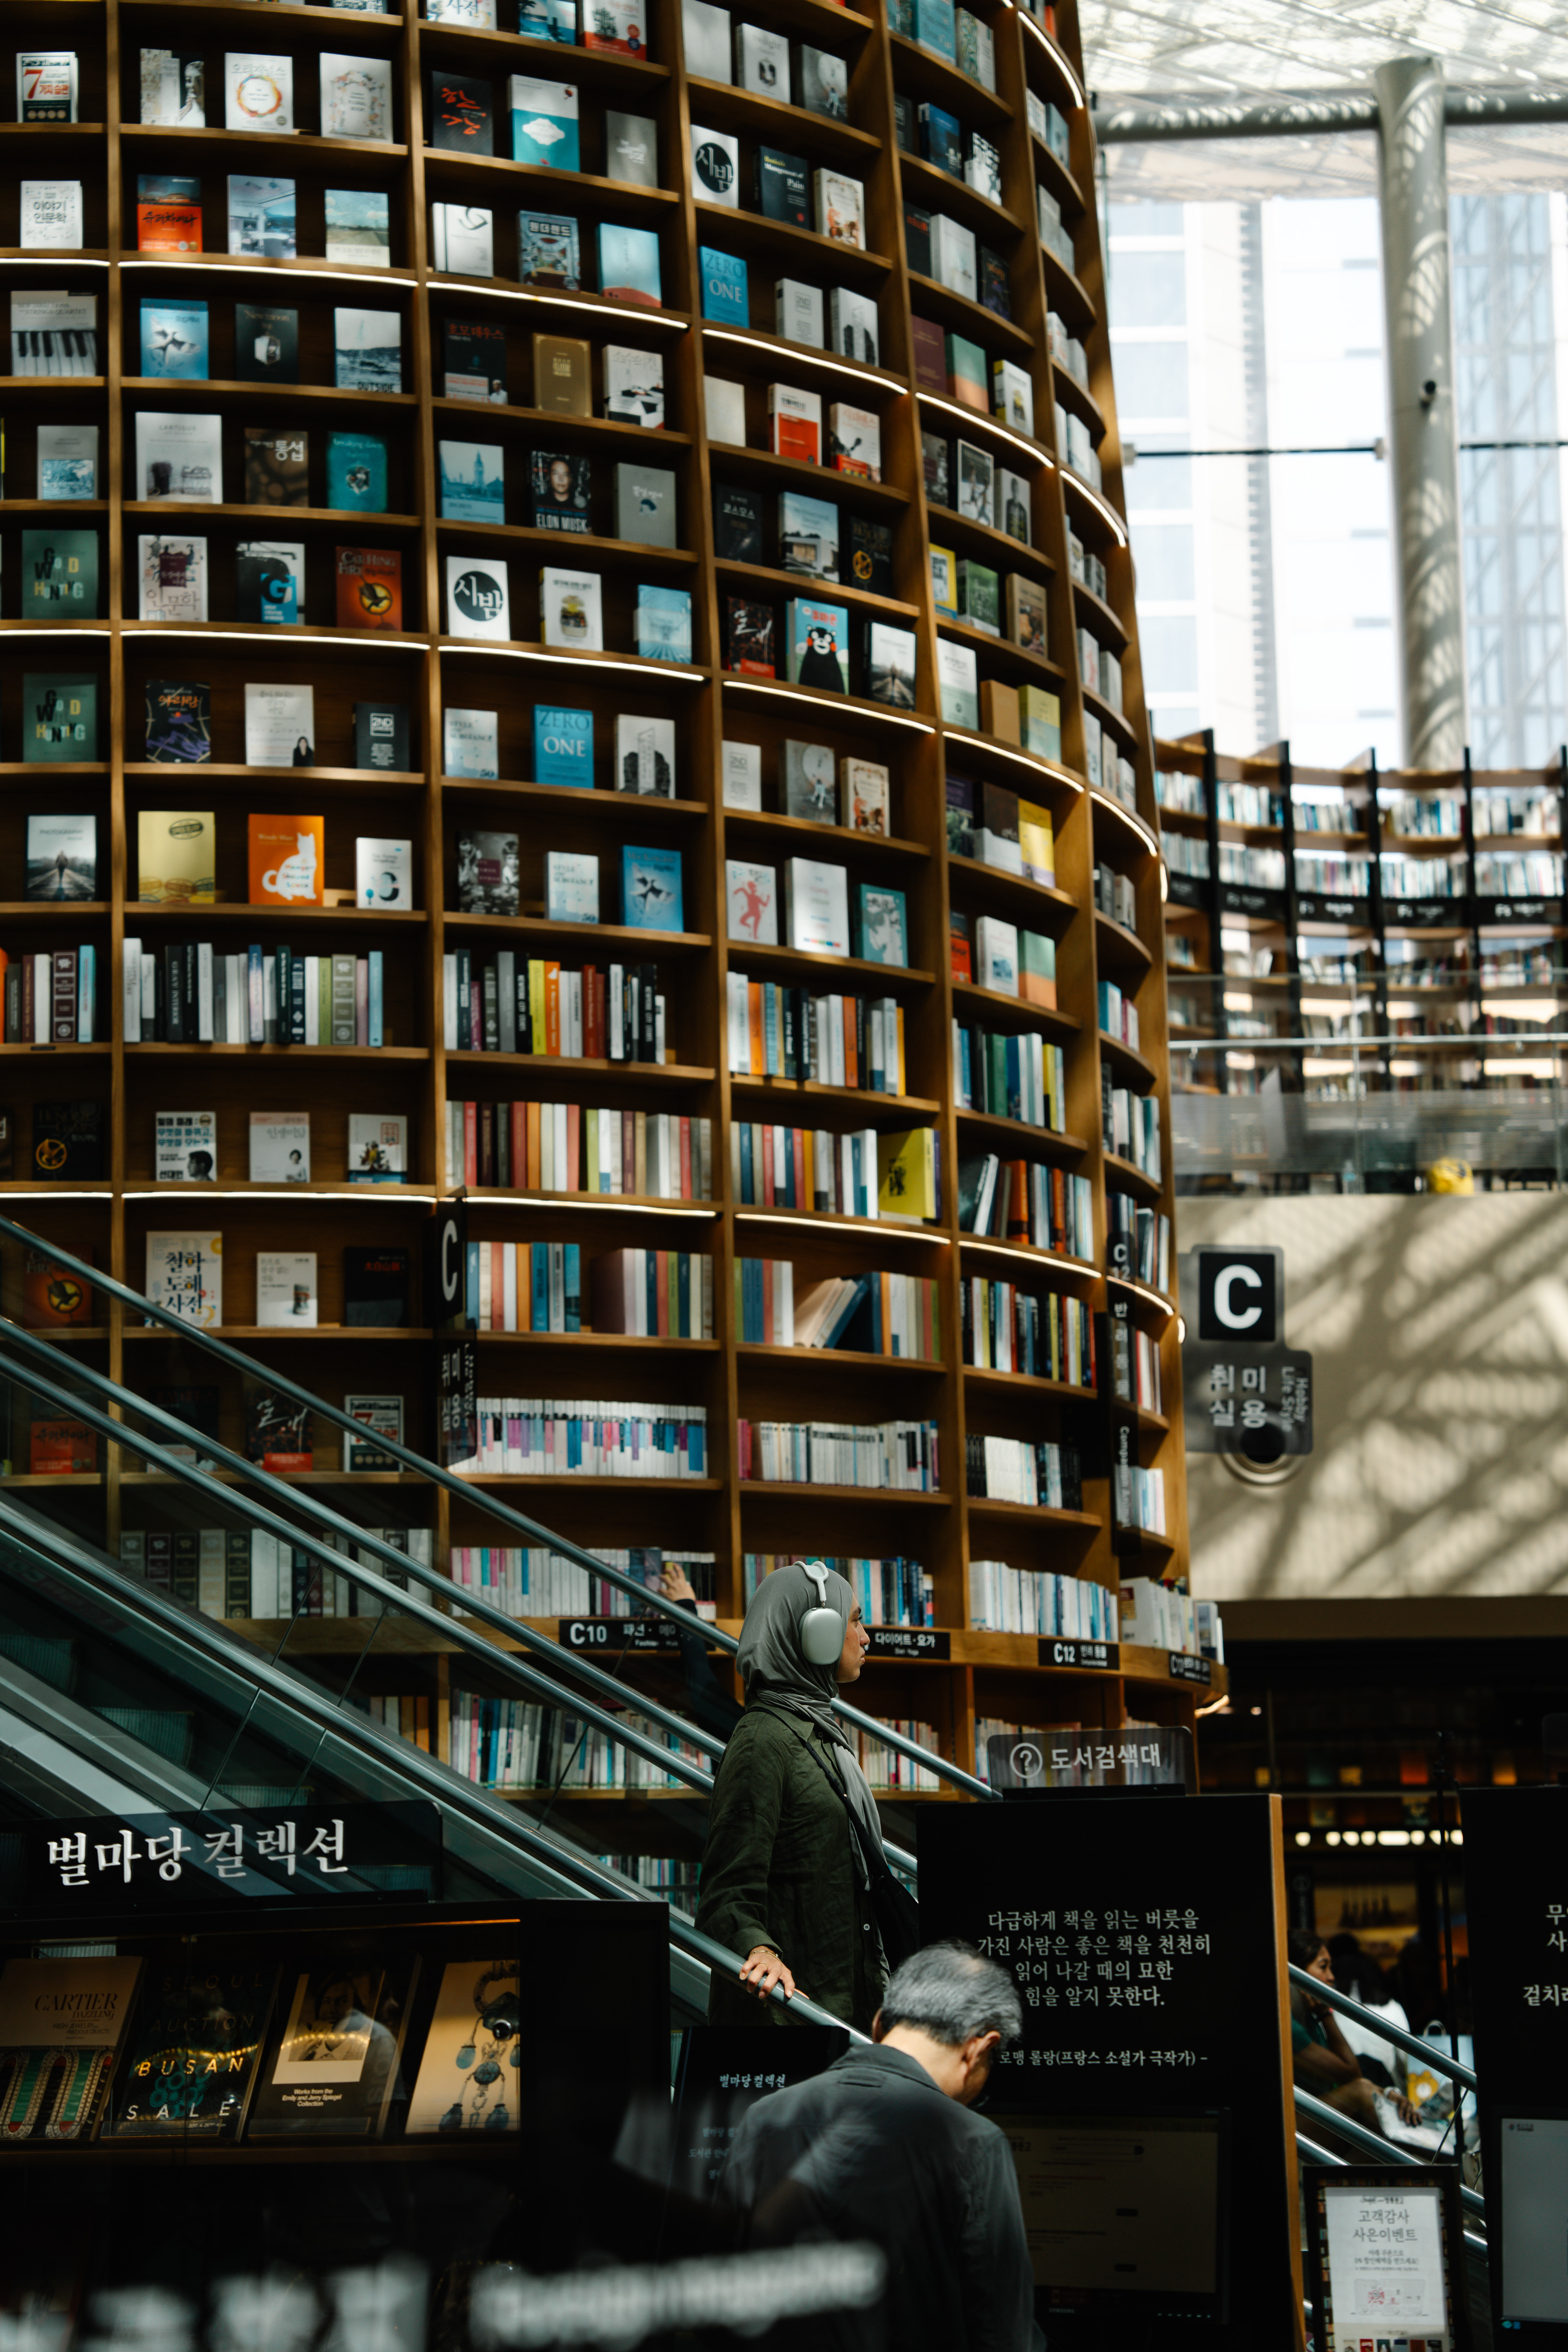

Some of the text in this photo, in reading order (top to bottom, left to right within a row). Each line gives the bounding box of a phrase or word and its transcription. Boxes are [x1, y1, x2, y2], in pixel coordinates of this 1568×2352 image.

[23, 69, 44, 99] 7
[34, 200, 67, 212] 이야기
[34, 212, 67, 224] 인문학
[704, 253, 745, 278] ZERO
[708, 279, 743, 303] ONE
[274, 439, 304, 461] 통섭
[536, 513, 588, 532] ELON MUSK
[454, 575, 503, 621] 시밤
[158, 695, 199, 708] 아리랑
[538, 710, 590, 731] ZERO
[543, 736, 586, 757] ONE
[165, 1251, 205, 1273] 철학
[442, 1219, 458, 1301] C
[1113, 1243, 1127, 1263] C
[164, 1274, 202, 1292] 도해
[165, 1294, 202, 1314] 사전
[1214, 1264, 1263, 1329] C
[1210, 1364, 1266, 1394] 취미
[1281, 1366, 1295, 1393] Life
[1294, 1376, 1308, 1423] Hobby
[1209, 1399, 1267, 1429] 실용
[570, 1623, 607, 1645] C10
[1053, 1642, 1076, 1663] C12
[1051, 1742, 1161, 1770] 도서검색대
[47, 1818, 349, 1886] 별마당 컬렉션
[988, 1908, 1199, 1931] 다급하게 책을 읽는 버릇을
[977, 1933, 1211, 1956] 가진 사람은 좋은 책을 천천히
[1016, 1960, 1174, 1982] 읽어 나갈 때의 묘한
[34, 1993, 118, 2011] CARTIER
[1025, 1986, 1165, 2007] 힘을 알지 못한다.
[72, 2010, 115, 2020] DAZZLING
[138, 2057, 243, 2076] BUSAN
[999, 2049, 1196, 2067] 로맹 롤랑(프랑스 소설가 극작가)
[719, 2073, 786, 2088] 별마당 컬렉션
[126, 2101, 231, 2120] SALE
[1359, 2209, 1410, 2224] 고객감사
[1353, 2227, 1417, 2243] 사은이벤트
